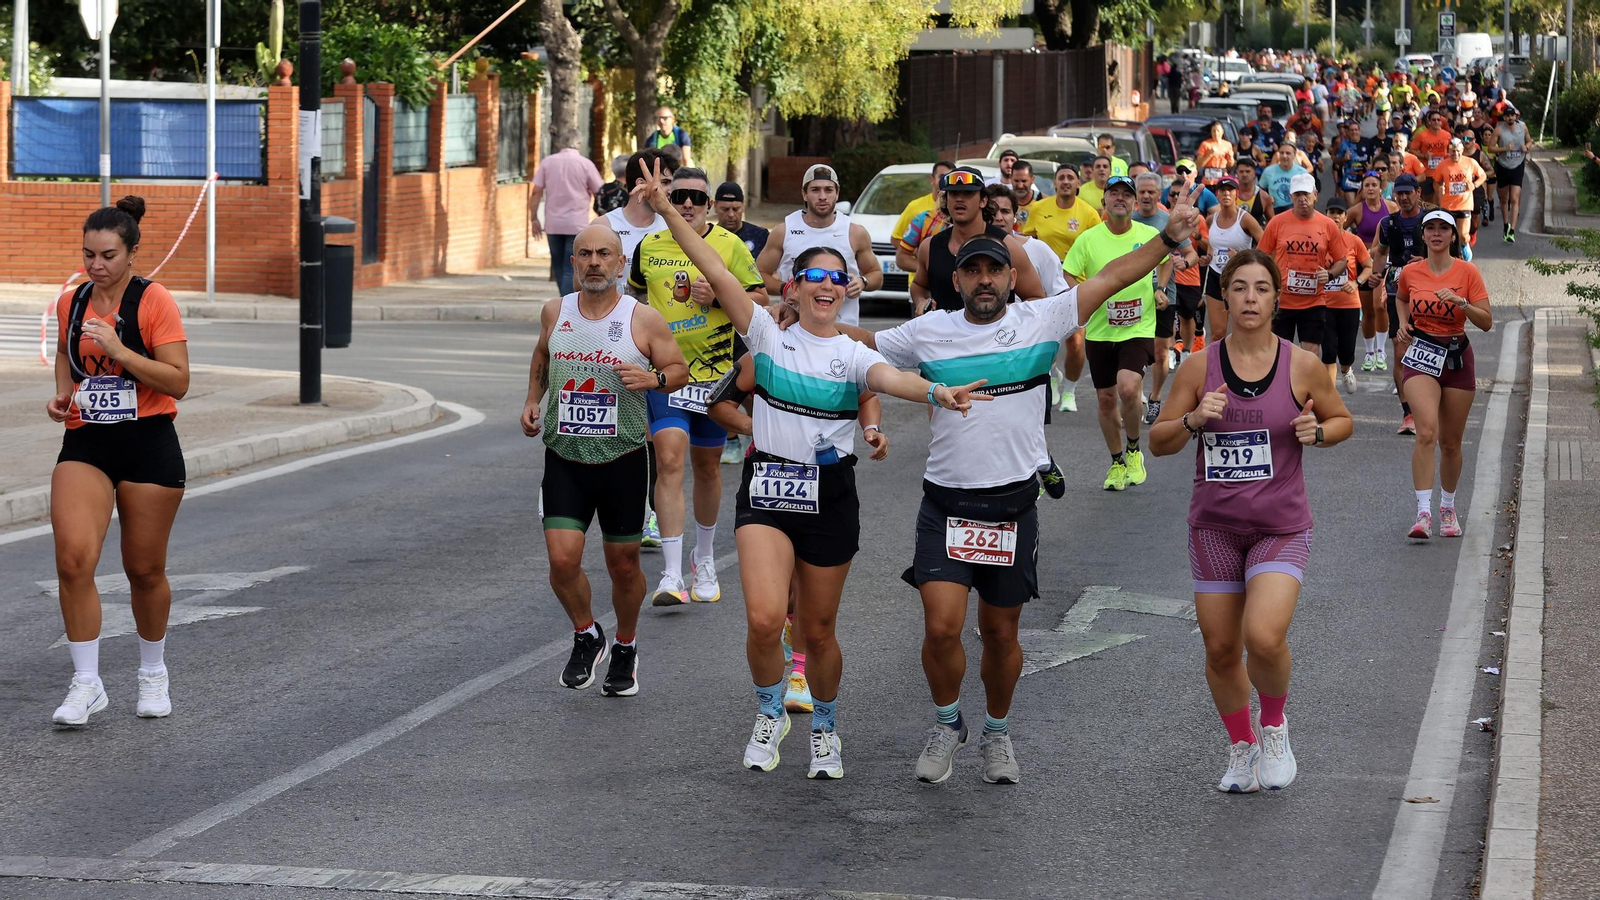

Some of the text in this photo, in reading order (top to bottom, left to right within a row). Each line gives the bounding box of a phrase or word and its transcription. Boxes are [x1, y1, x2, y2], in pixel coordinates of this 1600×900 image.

[1286, 240, 1319, 253] XXIX
[1295, 279, 1310, 287] 276
[1116, 309, 1135, 318] 225
[1412, 299, 1456, 318] XXIX
[554, 349, 622, 365] maratón
[1412, 348, 1437, 365] 1044
[998, 384, 1024, 393] ESPERANZA
[88, 393, 120, 408] 965
[568, 407, 608, 422] 1057
[1226, 408, 1263, 424] NEVER
[1220, 448, 1253, 464] 919
[762, 480, 807, 498] 1124
[964, 530, 999, 548] 262
